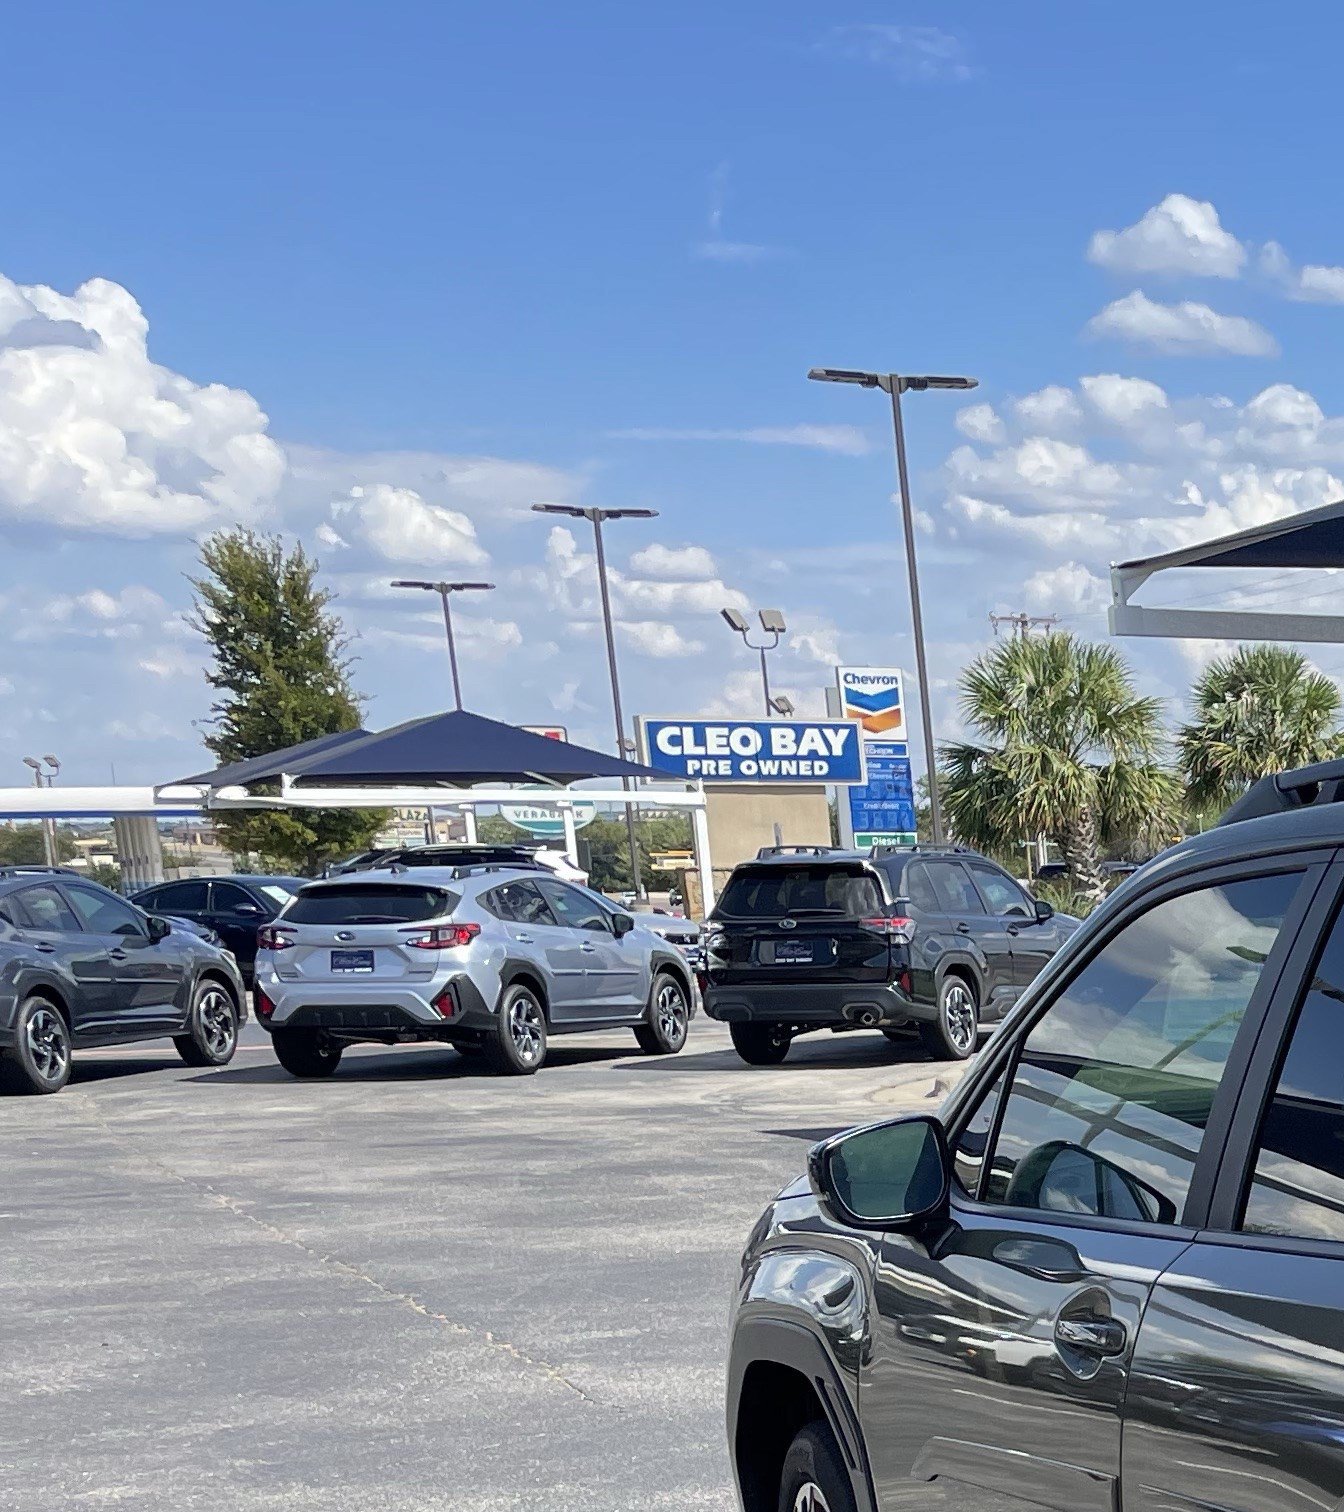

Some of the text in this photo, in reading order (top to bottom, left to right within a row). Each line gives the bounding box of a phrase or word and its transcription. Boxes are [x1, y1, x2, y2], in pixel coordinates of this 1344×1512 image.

[843, 672, 898, 686] Chevron
[656, 726, 850, 757] CLEO BAY
[687, 759, 829, 776] PRE OWNED
[513, 804, 583, 819] VERABK
[872, 837, 900, 846] Diesel
